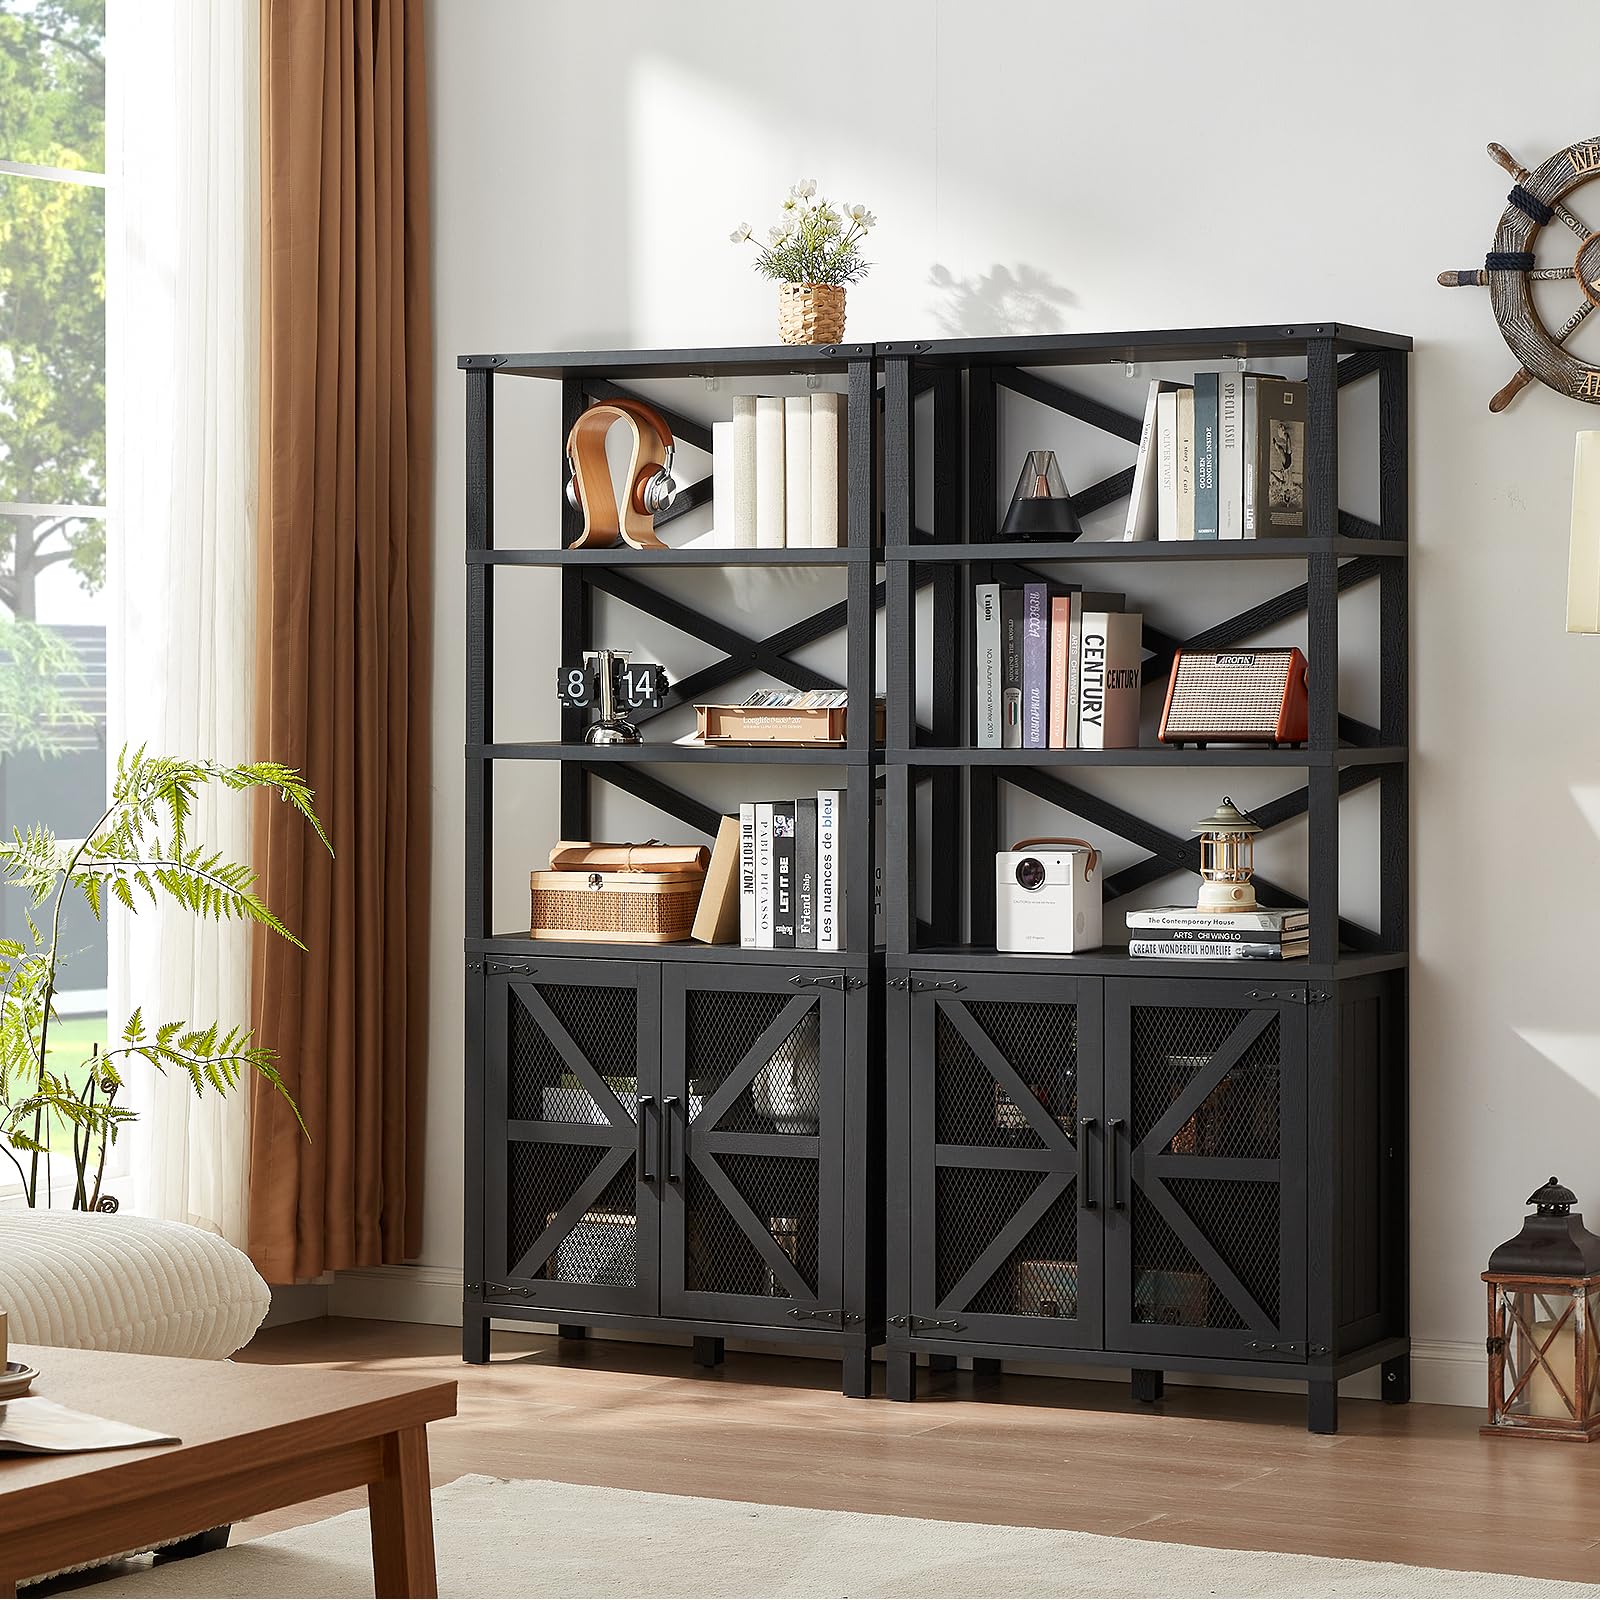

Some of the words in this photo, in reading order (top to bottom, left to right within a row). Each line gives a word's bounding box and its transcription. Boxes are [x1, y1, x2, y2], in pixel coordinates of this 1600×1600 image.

[1225, 383, 1235, 421] SPECIAL
[1163, 428, 1171, 462] OLIVER
[1225, 425, 1235, 449] ISSUE
[1163, 463, 1171, 490] TWIST
[1183, 465, 1190, 474] of
[984, 594, 993, 622] Union
[1029, 591, 1041, 639] REBECCA
[567, 669, 585, 698] 8
[622, 670, 654, 699] 14
[1082, 634, 1105, 727] CENTURY
[1106, 669, 1139, 689] CENTURY
[822, 798, 833, 828] bleu
[743, 824, 753, 840] DIE
[760, 821, 768, 866] PABLO
[822, 832, 832, 849] de
[743, 842, 754, 867] ROTE
[780, 857, 789, 874] BE
[743, 869, 754, 895] ZONE
[780, 876, 789, 887] IT
[802, 873, 812, 892] Ship
[823, 854, 832, 913] nuances
[760, 873, 768, 930] PICASSO
[780, 890, 789, 913] LET
[801, 894, 811, 934] Friend
[822, 918, 832, 942] Les
[1162, 917, 1212, 927] Contemporary
[1213, 918, 1235, 926] House
[1173, 932, 1193, 940] ARTS
[1133, 943, 1157, 954] CREATE
[1159, 944, 1199, 955] WONDERFUL
